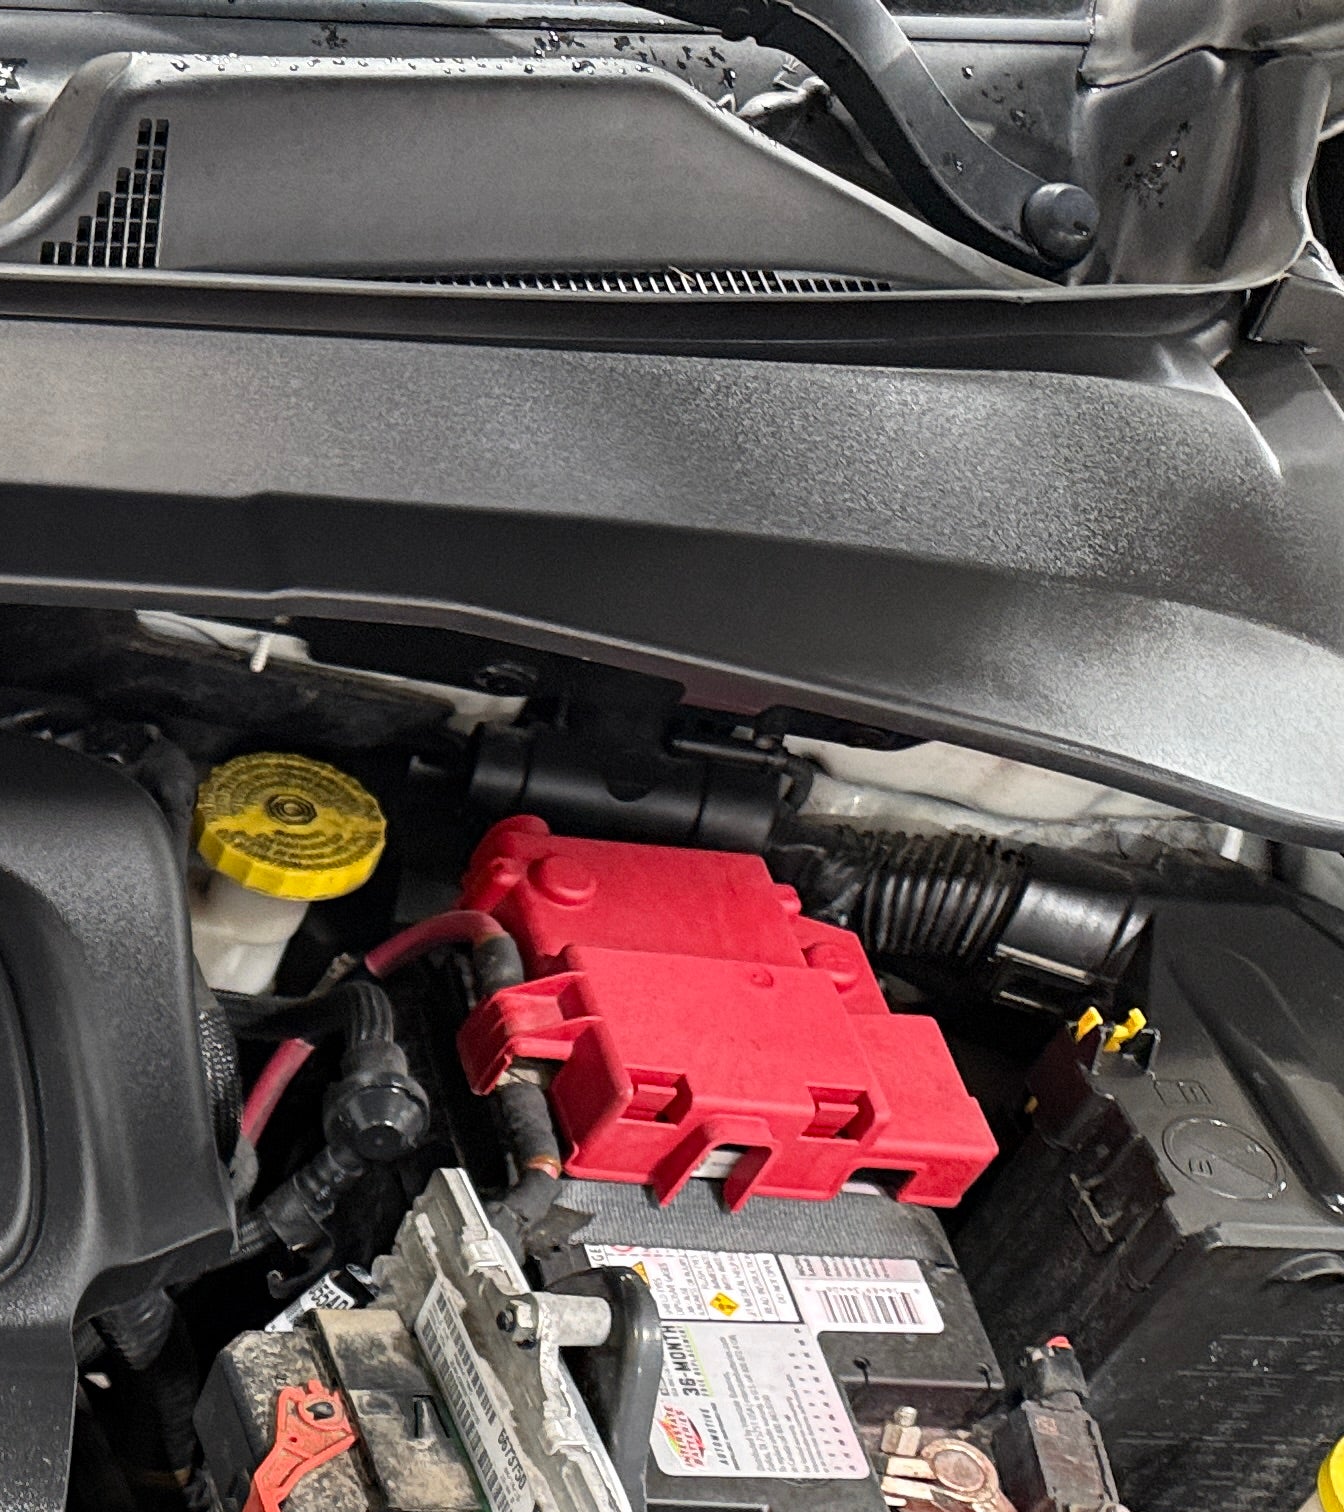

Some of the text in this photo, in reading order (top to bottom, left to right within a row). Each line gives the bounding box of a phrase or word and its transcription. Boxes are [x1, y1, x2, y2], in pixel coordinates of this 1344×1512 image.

[661, 1325, 700, 1397] 36-MONTH
[664, 1404, 693, 1468] INTERSTATE
[675, 1410, 705, 1467] BATTERIES
[699, 1407, 730, 1467] AUTOMOTIVE
